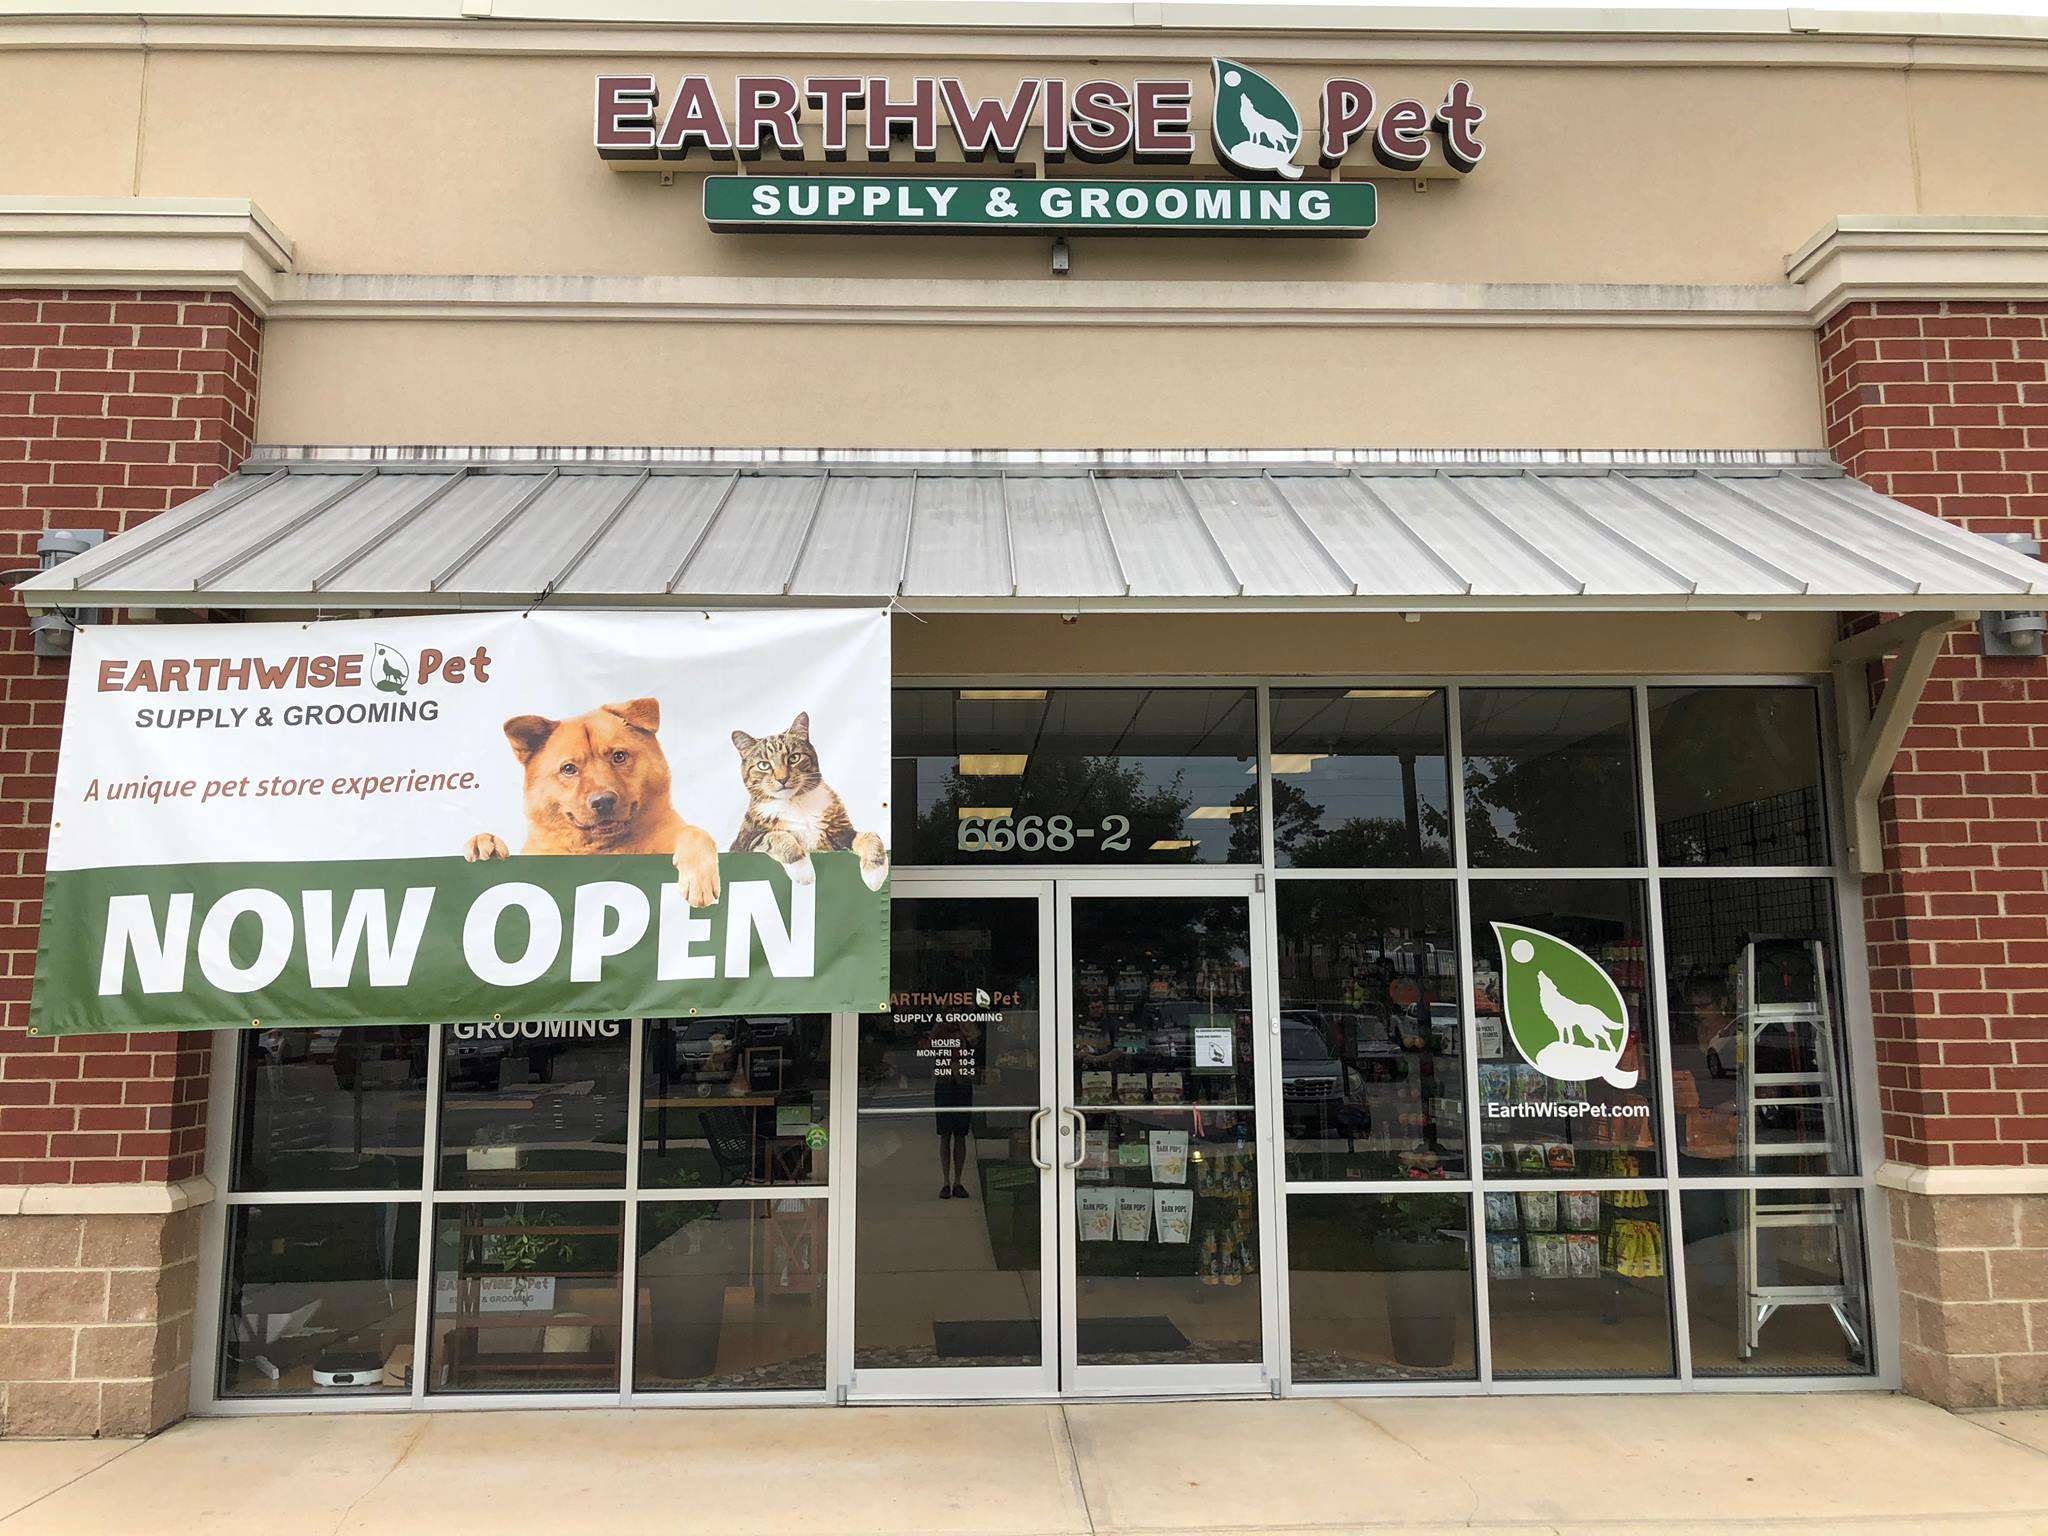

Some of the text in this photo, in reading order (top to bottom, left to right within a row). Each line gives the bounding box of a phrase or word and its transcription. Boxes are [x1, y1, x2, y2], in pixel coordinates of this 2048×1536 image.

[594, 74, 1487, 168] EARTHWISE Pet
[751, 185, 1332, 221] SUPPLY & GROOMING
[97, 646, 492, 693] EARTHWISE Pet
[135, 700, 439, 729] SUPPLY & GROOMING
[84, 768, 481, 805] A unique pet store experience.
[957, 815, 1132, 852] 6668-2
[99, 879, 816, 995] NOW OPEN
[890, 991, 1021, 1006] ARTHWISE Pet
[893, 1012, 1003, 1023] SUPPLY & GROOMING
[453, 1018, 620, 1039] GROOMING
[916, 1049, 976, 1057] MON-FRI 10-7
[931, 1039, 961, 1048] HOURS
[934, 1068, 976, 1076] SUN 12-5
[935, 1059, 952, 1067] SAT
[1487, 1102, 1650, 1118] EarthWisePet.com
